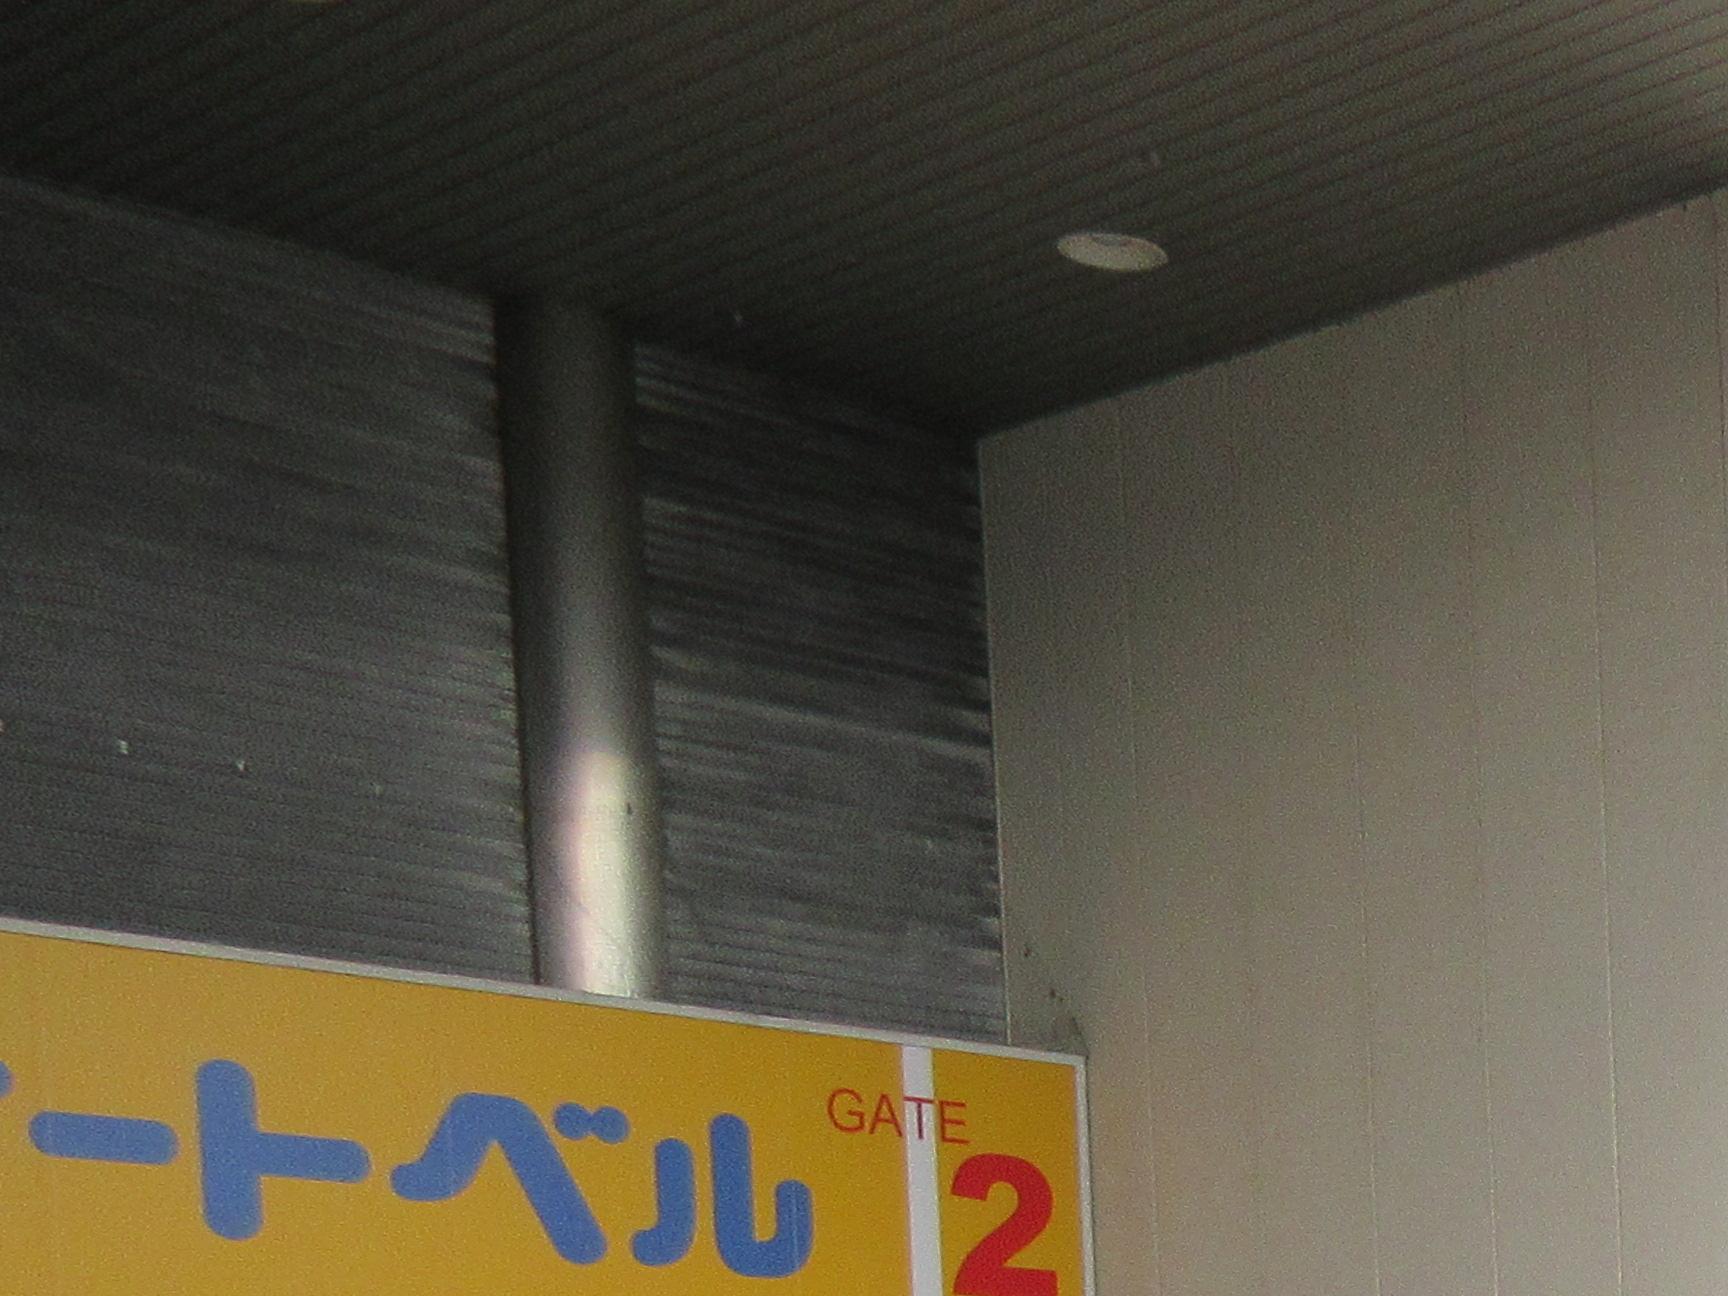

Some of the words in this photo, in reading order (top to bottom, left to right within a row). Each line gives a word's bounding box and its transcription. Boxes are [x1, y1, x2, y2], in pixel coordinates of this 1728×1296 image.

[0, 1059, 815, 1279] ートベル
[826, 1088, 971, 1144] GATE
